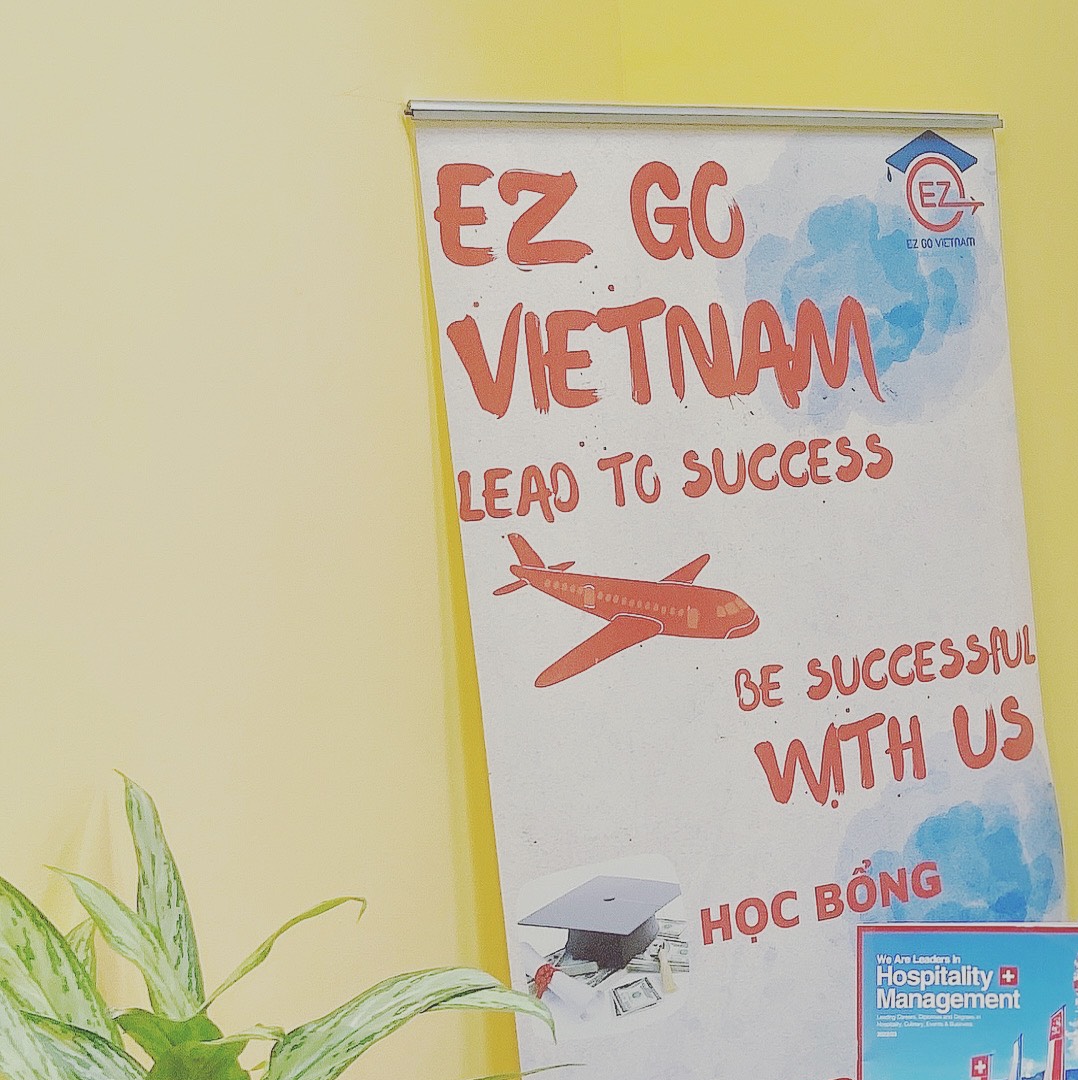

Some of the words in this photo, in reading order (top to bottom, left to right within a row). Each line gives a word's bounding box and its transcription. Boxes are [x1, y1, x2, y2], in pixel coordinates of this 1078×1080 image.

[435, 163, 593, 266] EZ
[630, 161, 745, 259] GO
[919, 181, 960, 208] EZ
[447, 296, 886, 419] VIETNAM
[458, 461, 579, 522] LEAD
[600, 452, 661, 507] TO
[683, 432, 893, 499] SUCCESS
[735, 664, 784, 711] BE
[807, 624, 1035, 700] SUCCESSFUL
[953, 696, 1034, 769] US
[700, 890, 800, 946] HỌC
[814, 859, 942, 922] BỔNG
[876, 965, 993, 991] Hospitality
[876, 988, 1020, 1014] Management
